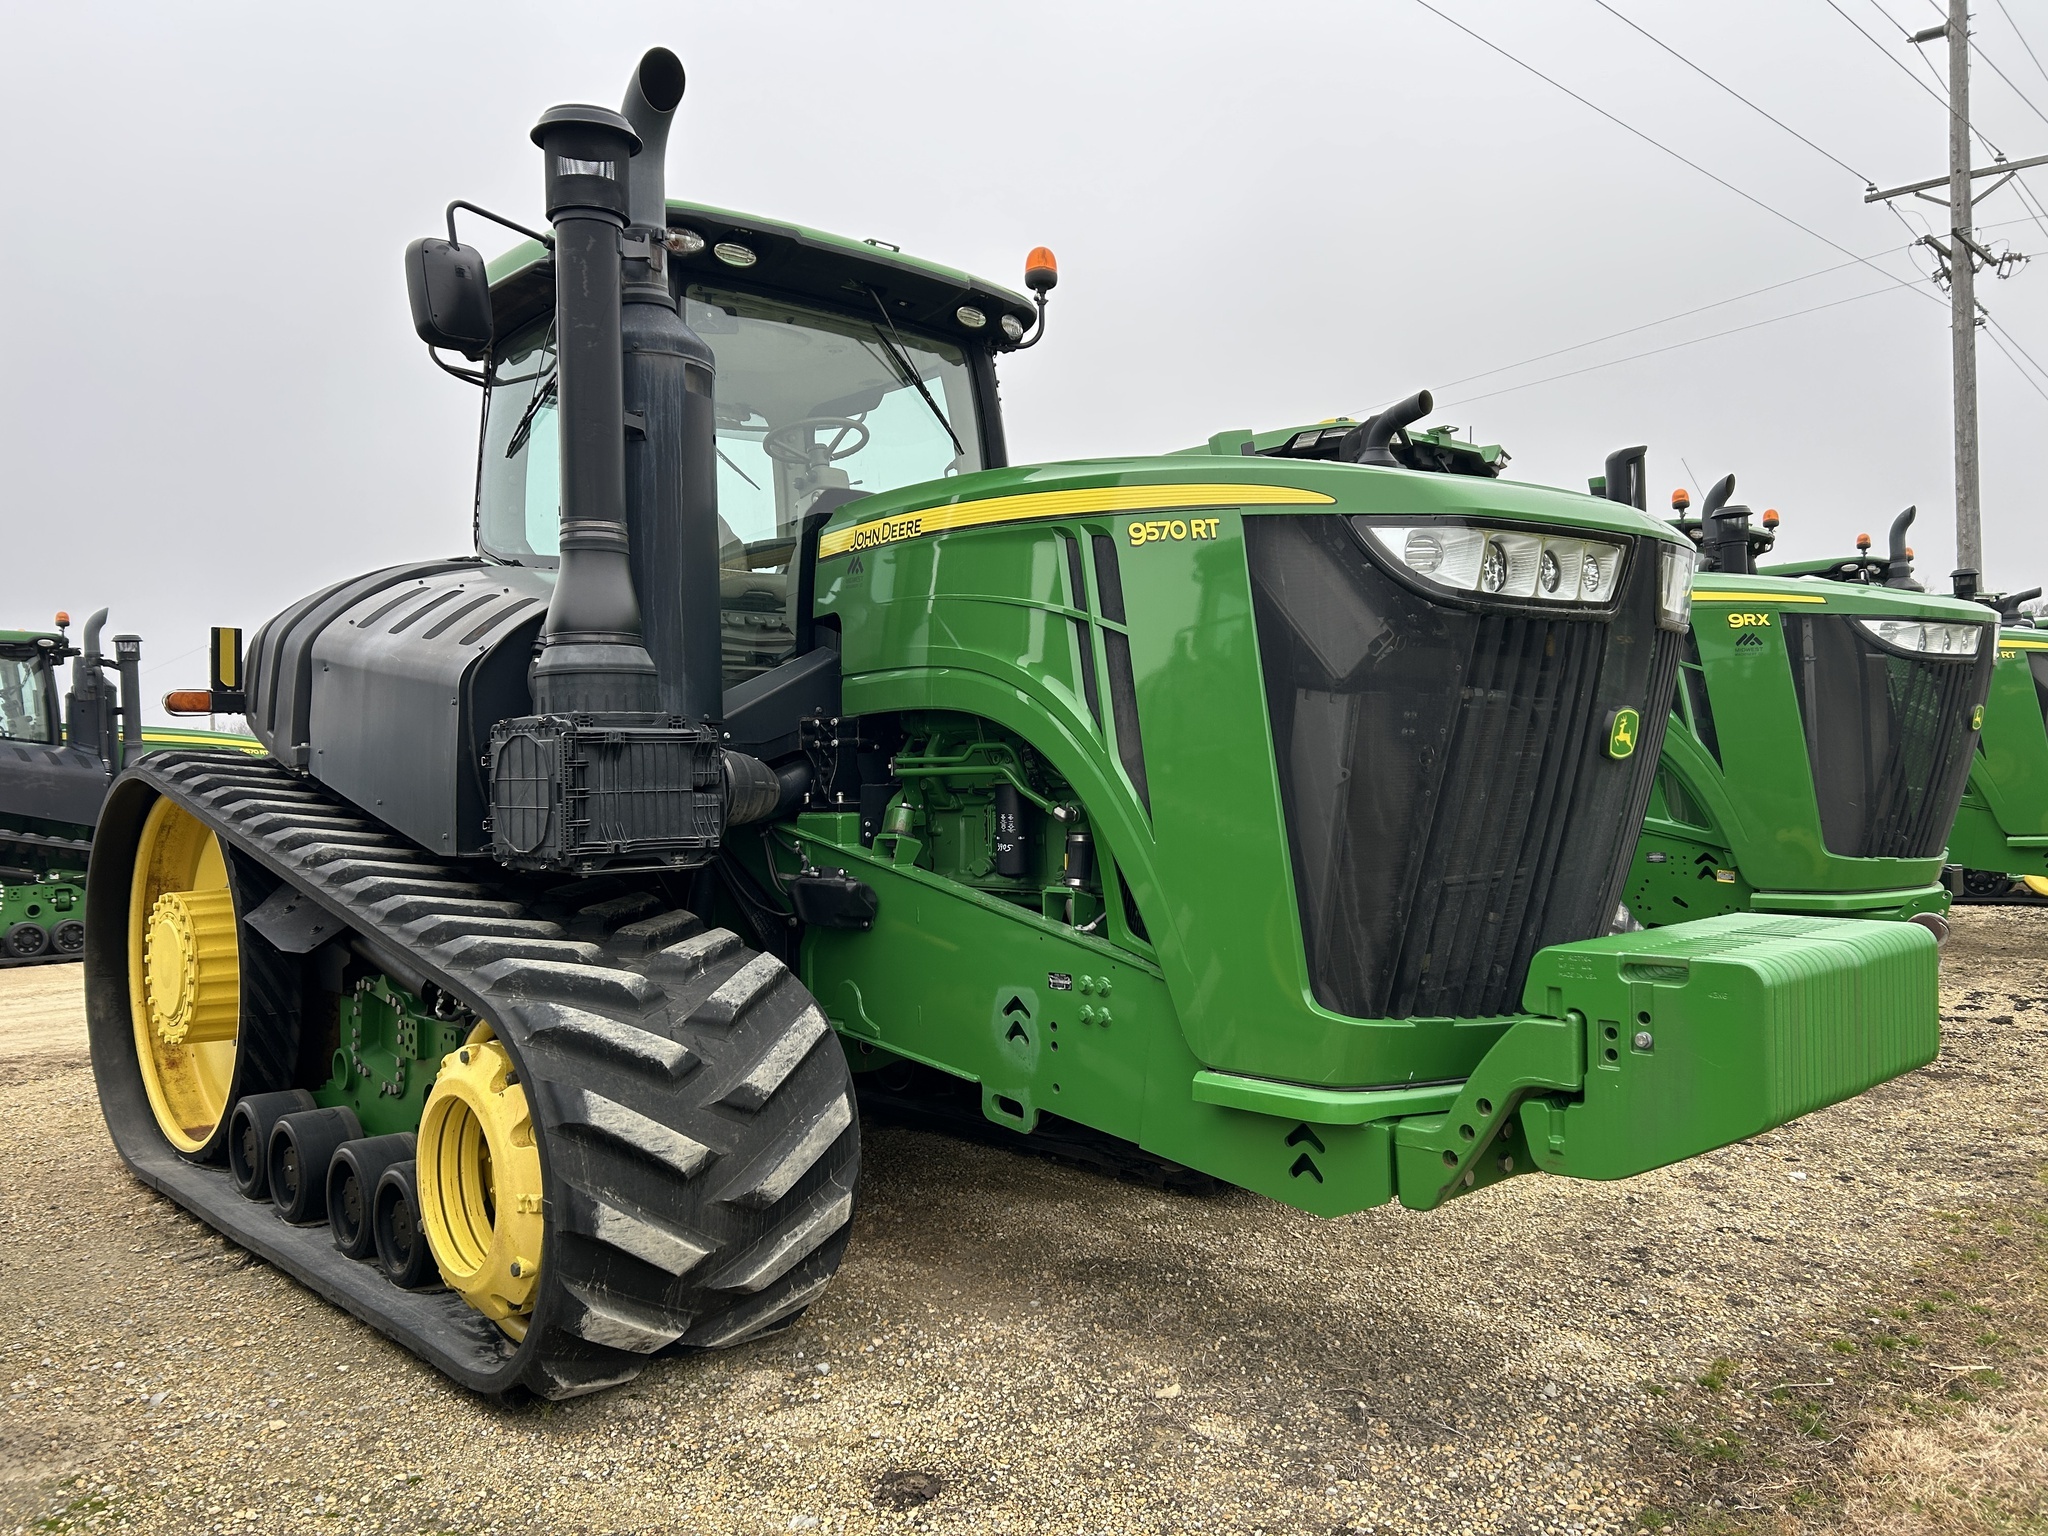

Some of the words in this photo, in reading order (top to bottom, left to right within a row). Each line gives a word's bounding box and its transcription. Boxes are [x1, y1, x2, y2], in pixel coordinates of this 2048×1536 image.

[849, 528, 881, 551] JOHN
[881, 518, 922, 541] DEERE
[1128, 519, 1187, 546] 9570
[1190, 518, 1220, 540] RT
[1727, 612, 1771, 629] 9RX
[2000, 650, 2016, 659] RT
